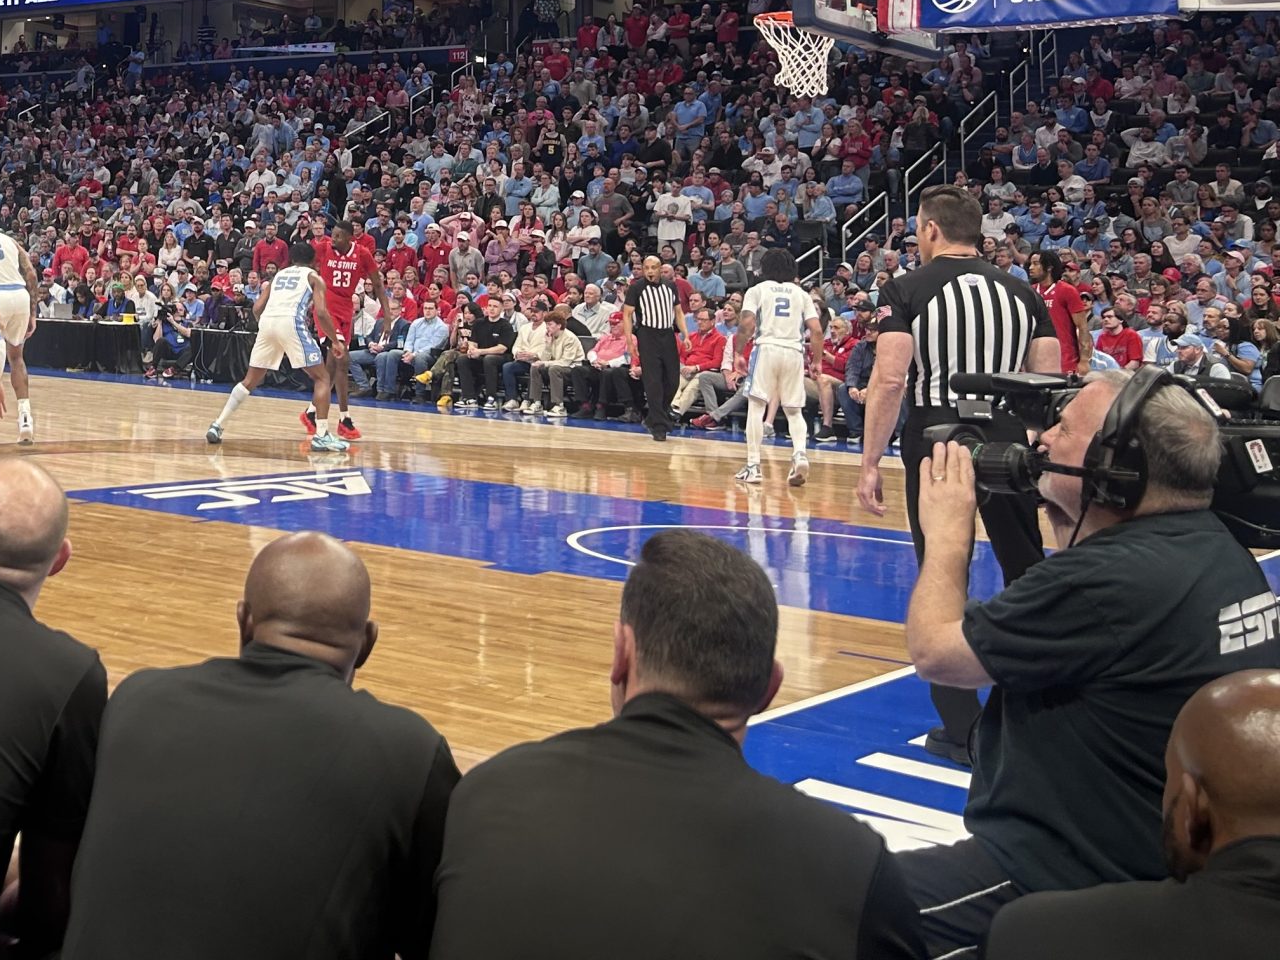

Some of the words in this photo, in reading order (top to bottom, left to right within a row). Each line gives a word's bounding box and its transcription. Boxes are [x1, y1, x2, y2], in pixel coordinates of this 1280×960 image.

[452, 51, 466, 61] 112
[327, 259, 338, 268] NC
[339, 261, 357, 271] STATE
[274, 276, 301, 292] 55
[332, 271, 352, 288] 23
[775, 297, 790, 317] 2
[1219, 591, 1280, 655] ESP
